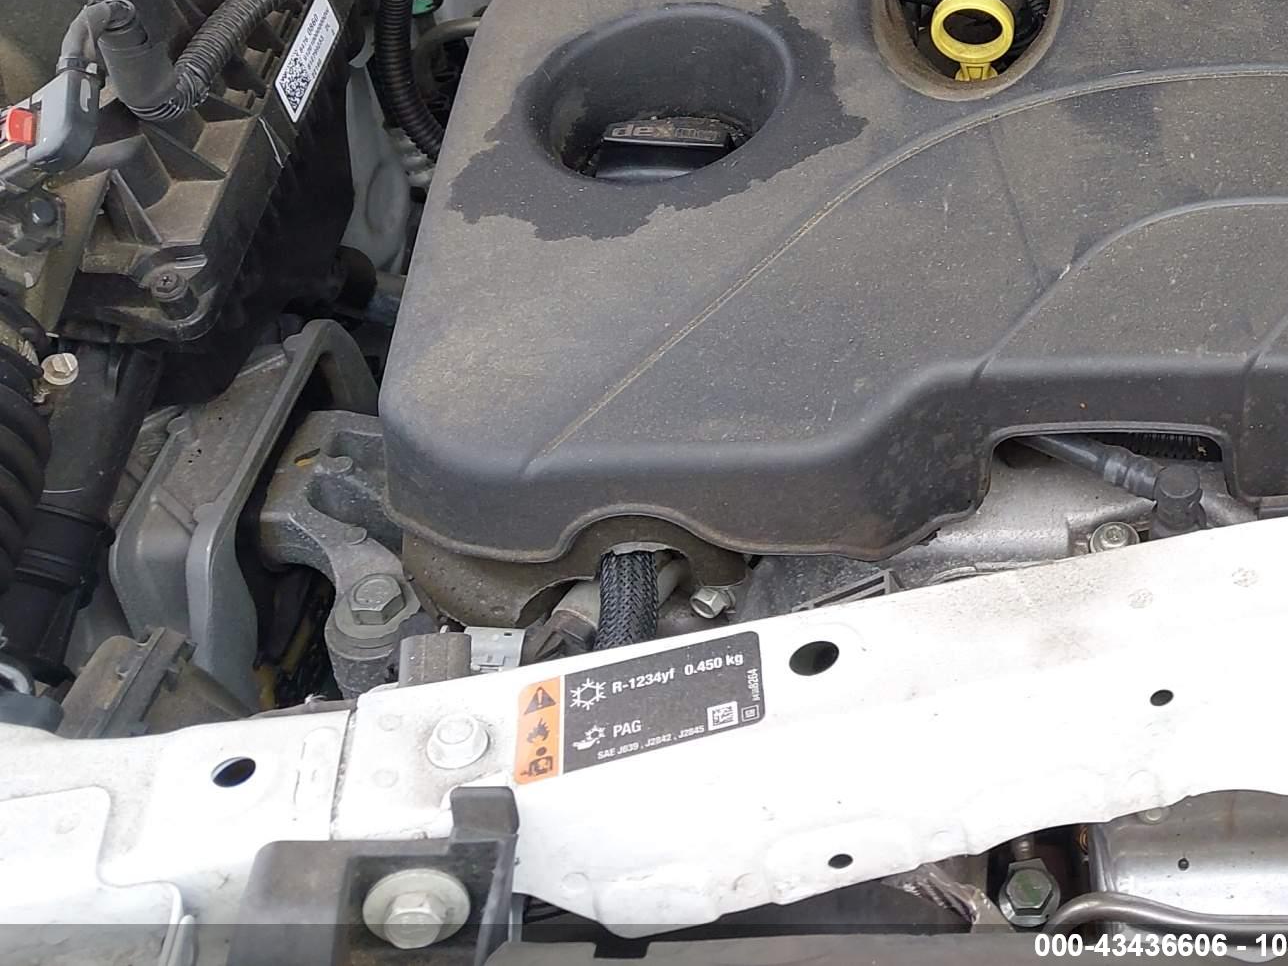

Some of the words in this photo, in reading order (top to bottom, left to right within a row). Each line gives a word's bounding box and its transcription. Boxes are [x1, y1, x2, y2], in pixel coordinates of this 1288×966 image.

[612, 668, 675, 693] R-1234yf
[684, 657, 722, 676] 0.450
[726, 654, 744, 668] kg
[612, 720, 642, 738] PAG
[597, 747, 616, 760] SAE
